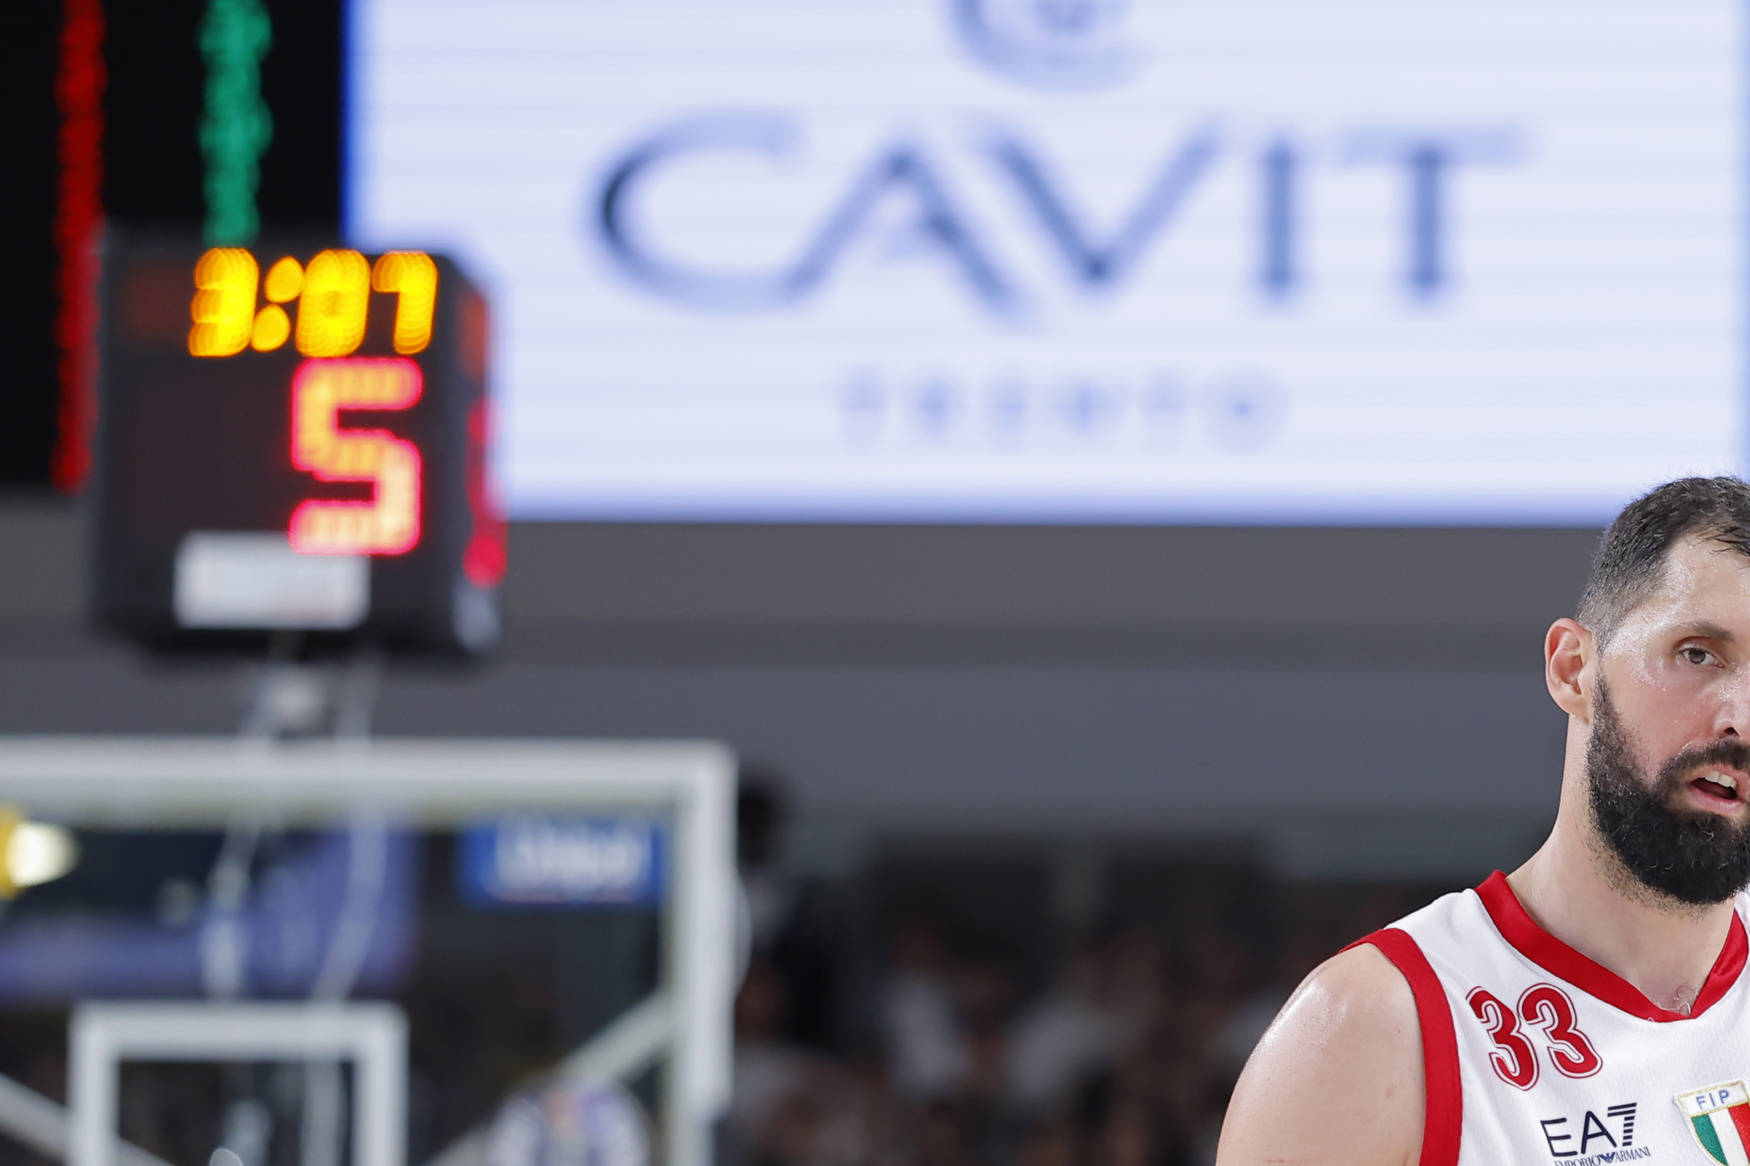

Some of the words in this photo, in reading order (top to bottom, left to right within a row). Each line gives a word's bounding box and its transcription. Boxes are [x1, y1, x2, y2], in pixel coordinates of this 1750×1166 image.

[592, 108, 1530, 318] CAVIT
[188, 246, 438, 357] 3:07
[290, 357, 424, 557] 5
[1465, 983, 1603, 1091] 33
[1540, 1102, 1637, 1157] EA7
[1695, 1089, 1730, 1110] FIP
[1613, 1146, 1651, 1163] ARMANI
